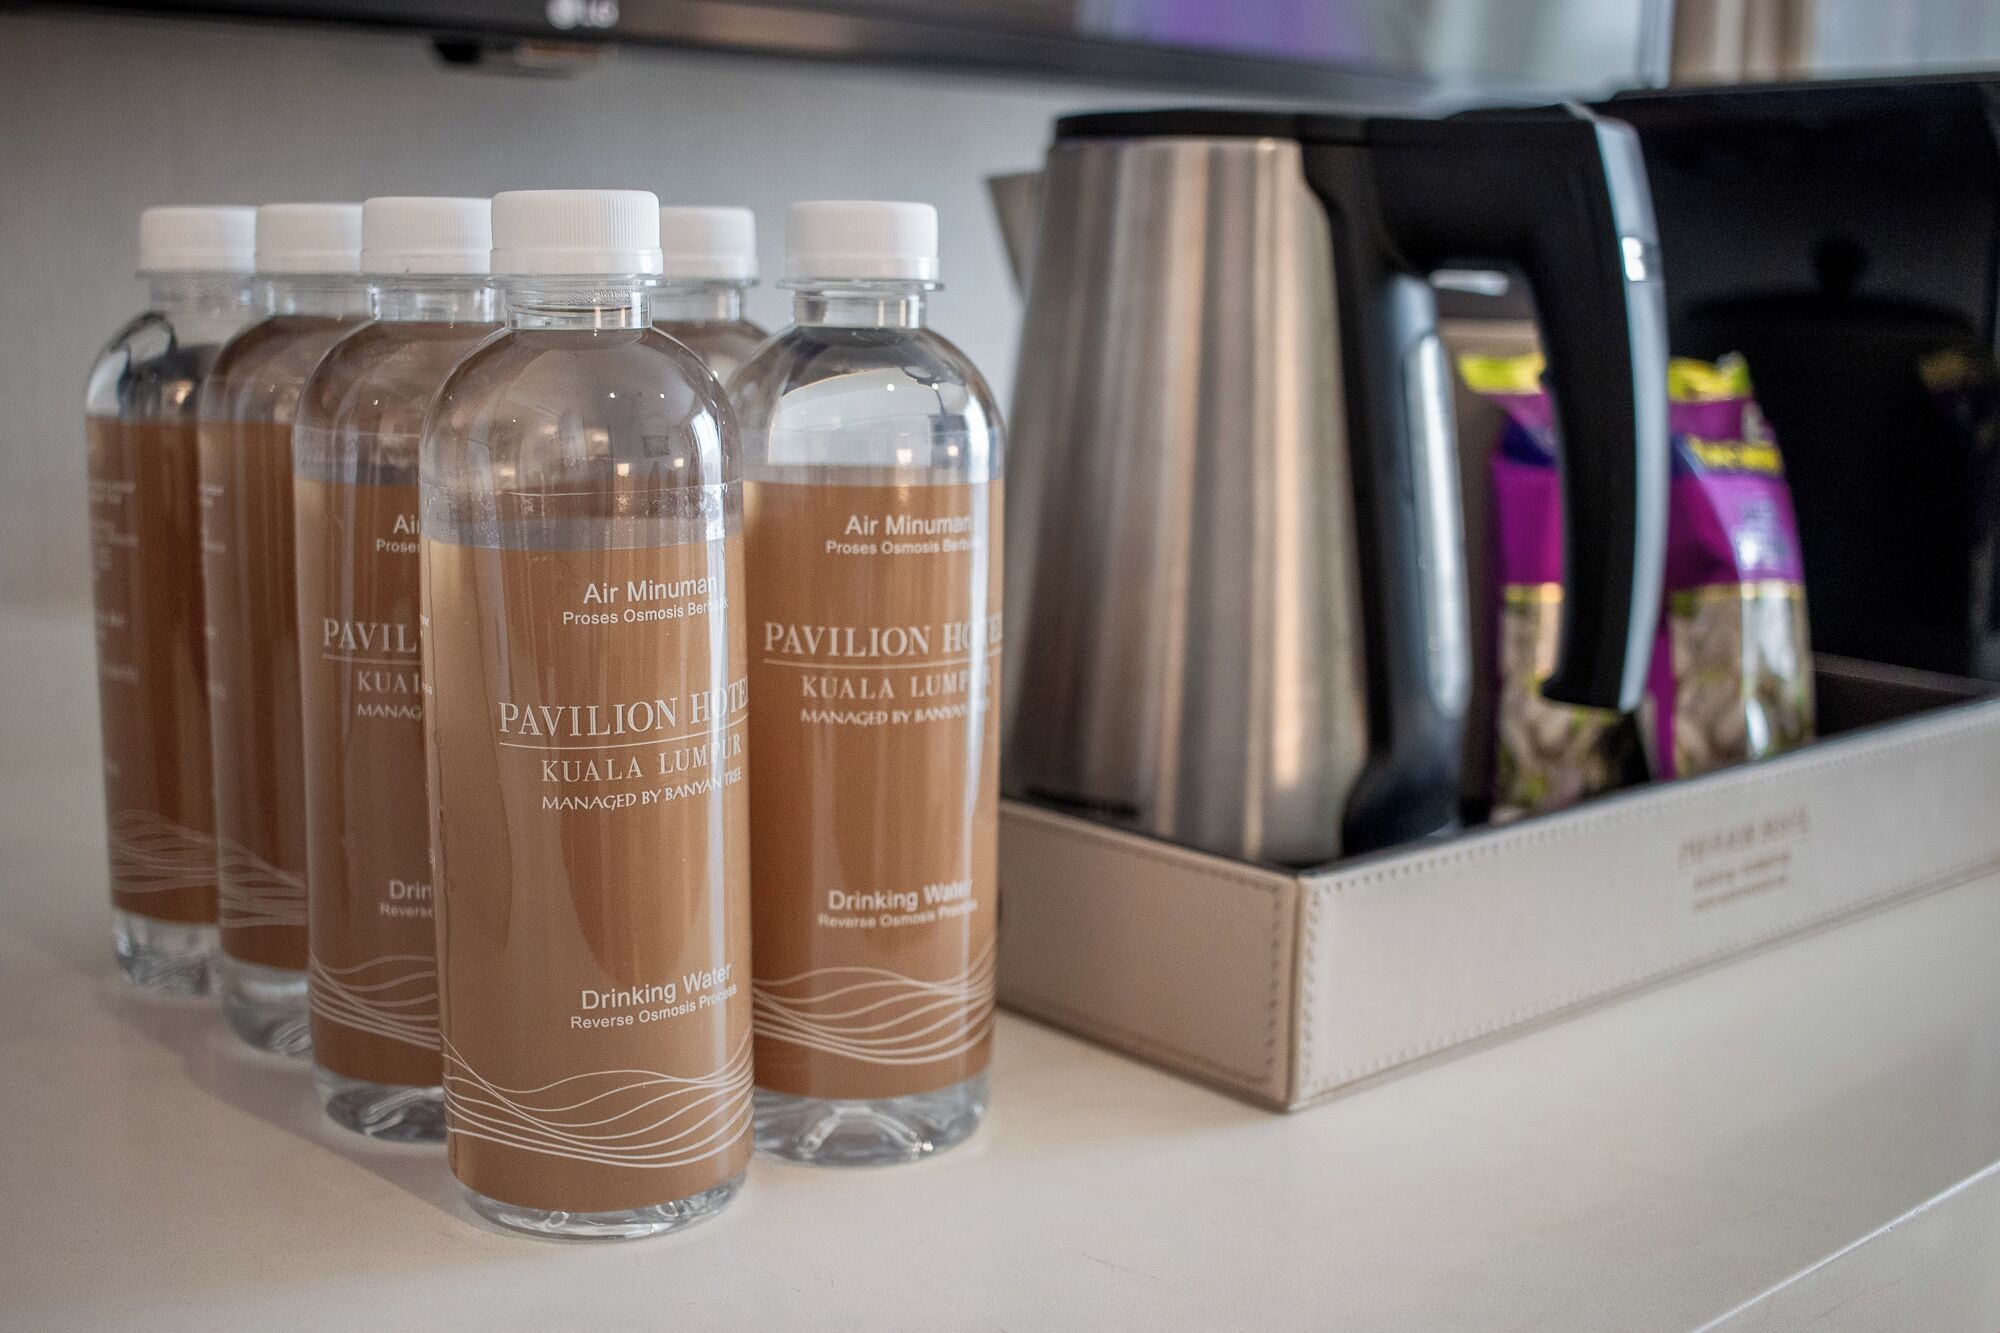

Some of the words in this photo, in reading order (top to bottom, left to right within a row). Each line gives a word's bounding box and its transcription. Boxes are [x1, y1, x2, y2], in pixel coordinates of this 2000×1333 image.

[844, 514, 879, 536] Air
[825, 539, 878, 555] Proses
[880, 539, 940, 555] Osmosis
[583, 583, 619, 605] Air
[627, 576, 716, 603] Minuman
[563, 611, 619, 625] Proses
[623, 604, 684, 623] Osmosis
[322, 616, 417, 653] PAVIL
[764, 621, 931, 658] PAVILION
[357, 670, 420, 694] KUA
[802, 675, 894, 700] KUALA
[357, 703, 422, 720] MANAG
[498, 697, 678, 737] PAVILION
[691, 676, 748, 724] HOTE
[801, 708, 888, 727] MANAGED
[892, 708, 913, 725] BY
[541, 756, 643, 783] KUALA
[659, 733, 742, 775] LUMPUR
[542, 793, 637, 811] MANAGED
[642, 789, 661, 805] BY
[665, 774, 722, 801] BANYAN
[724, 766, 742, 786] TREE
[828, 889, 918, 912] Drinking
[818, 913, 877, 928] Reverse
[582, 982, 677, 1010] Drinking
[683, 964, 732, 994] Water
[571, 1014, 634, 1029] Reverse
[639, 999, 697, 1024] Osmosis
[700, 983, 738, 1009] Process
